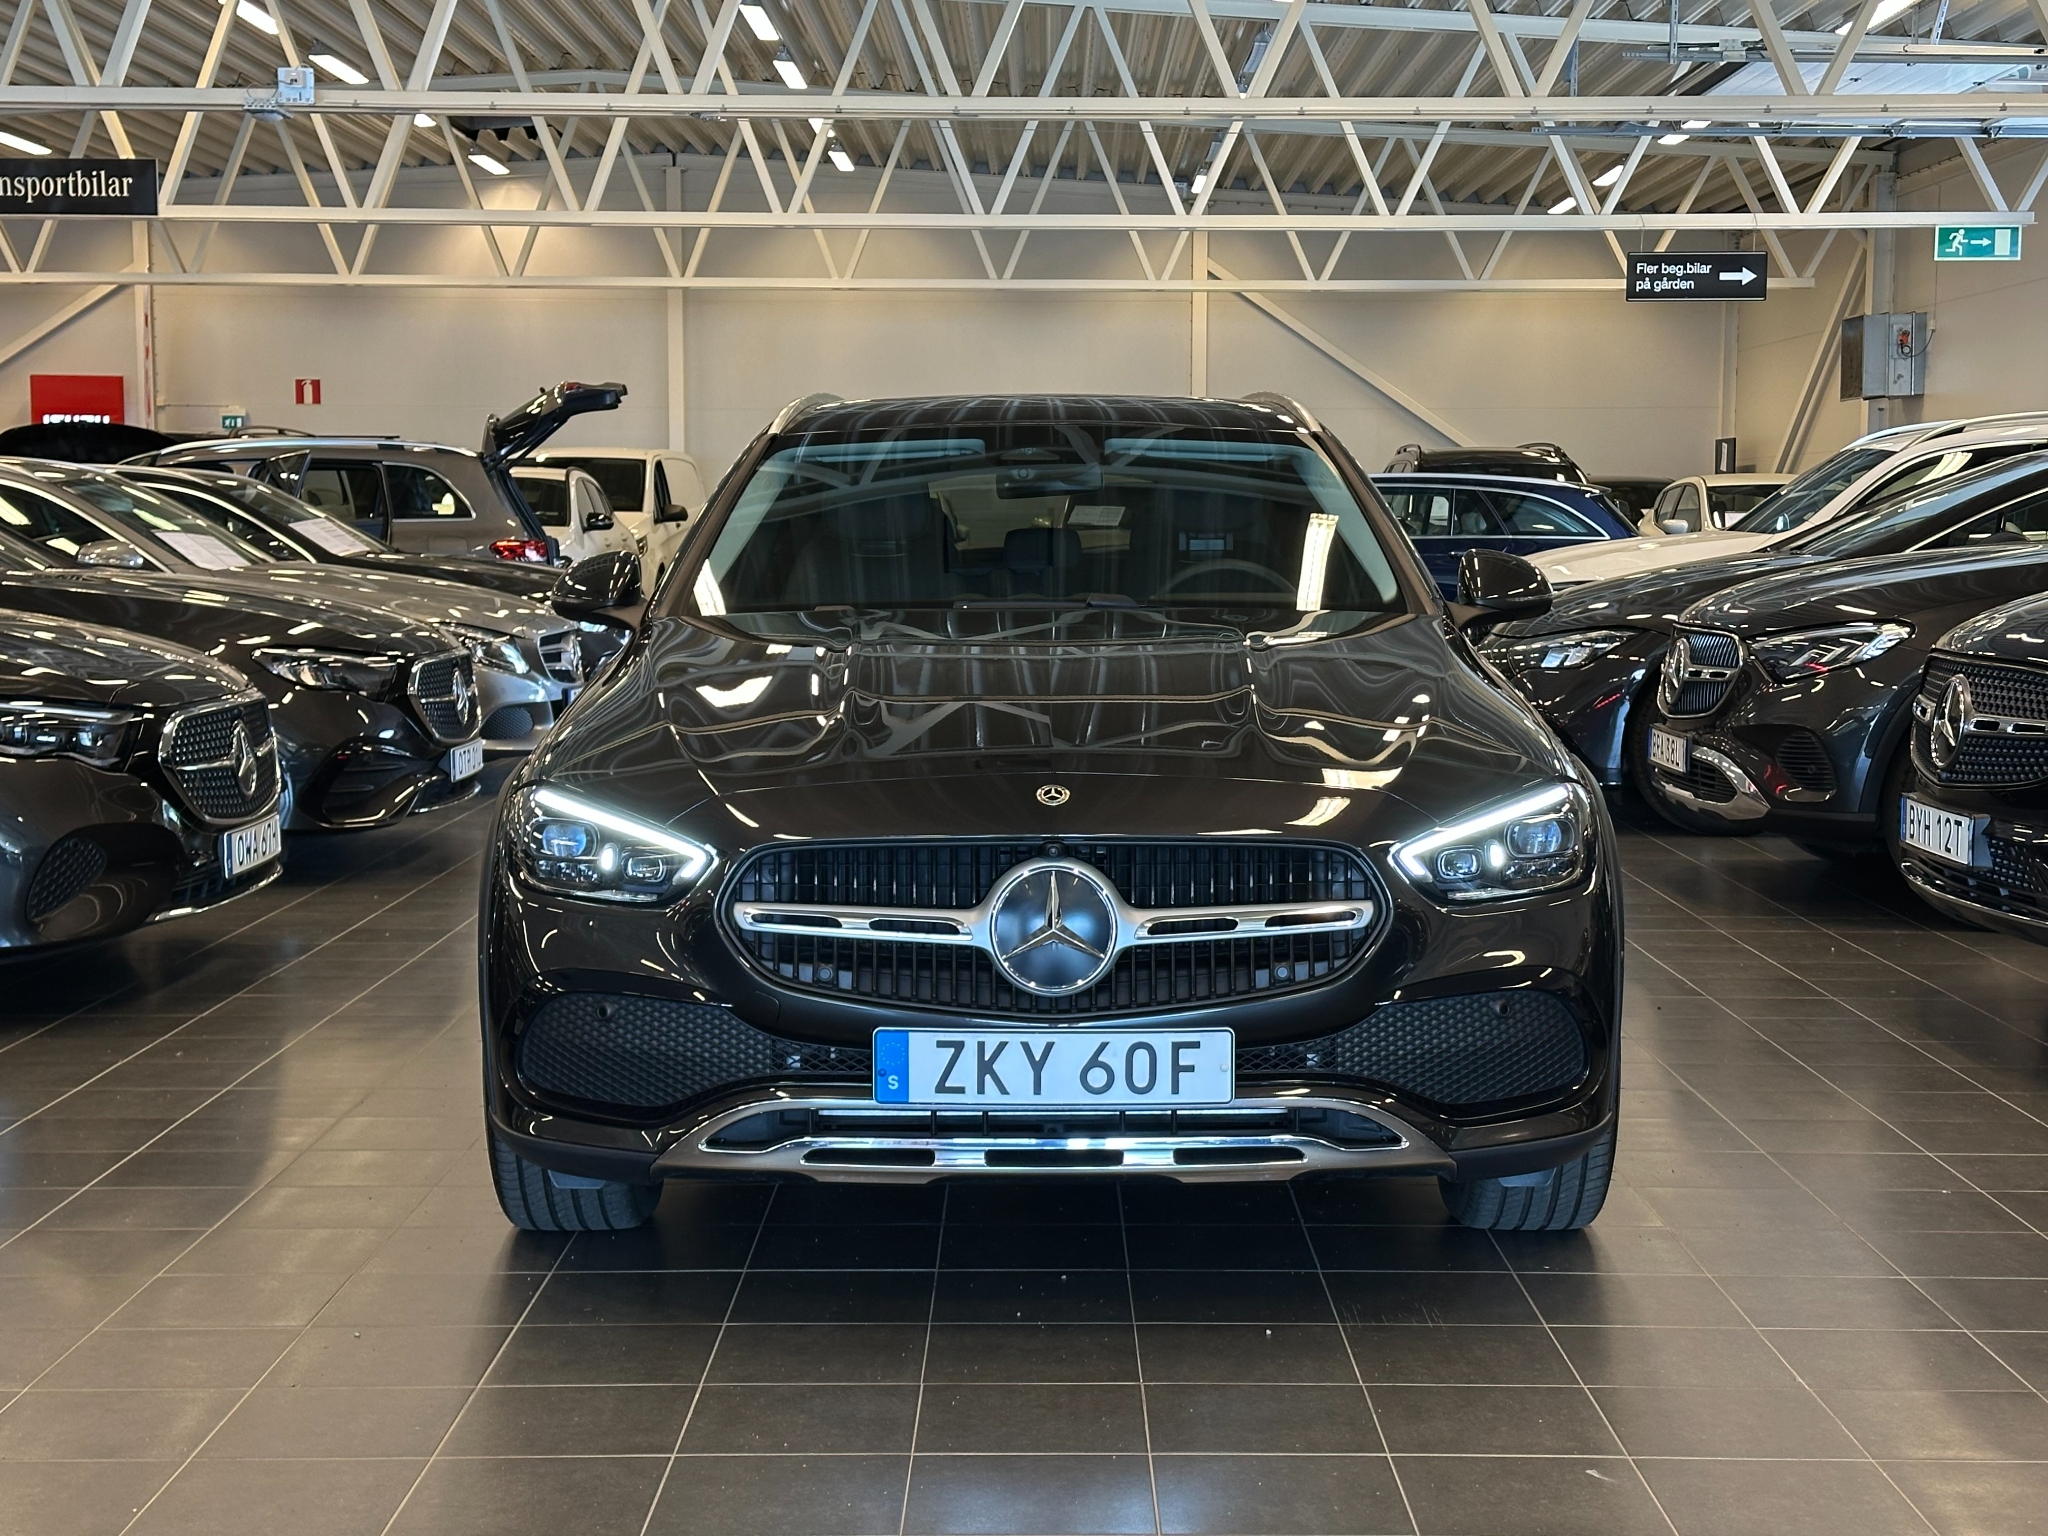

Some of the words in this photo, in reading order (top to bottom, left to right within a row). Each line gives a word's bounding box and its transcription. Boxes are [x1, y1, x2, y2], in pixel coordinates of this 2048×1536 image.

[0, 169, 133, 204] nsportbilar
[1636, 262, 1659, 274] Fler
[1661, 262, 1713, 276] beg.bilar
[1635, 277, 1651, 292] på
[1653, 277, 1695, 292] gården
[1909, 804, 1933, 848] BYH
[1936, 814, 1964, 857] 12T
[934, 1040, 1056, 1096] ZKY
[1079, 1040, 1201, 1096] 60F
[887, 1075, 899, 1090] S
